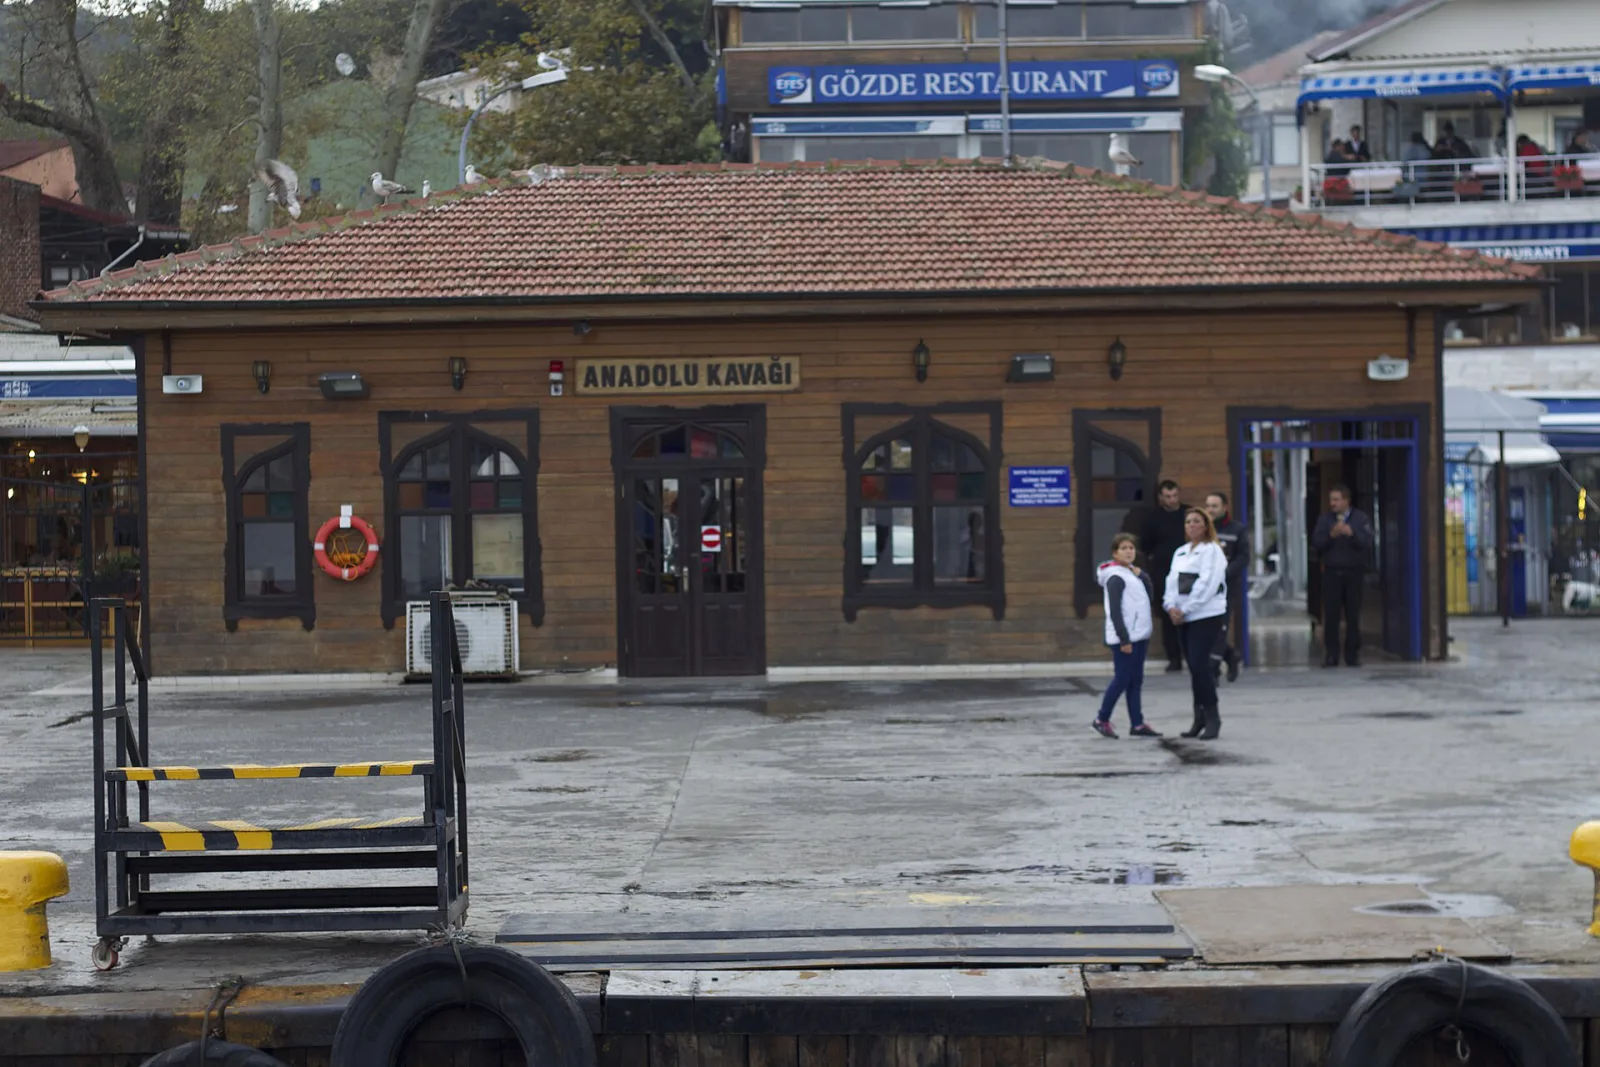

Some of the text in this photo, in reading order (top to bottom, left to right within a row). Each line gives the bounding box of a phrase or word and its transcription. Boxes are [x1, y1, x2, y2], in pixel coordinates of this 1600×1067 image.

[776, 79, 805, 90] EFES
[819, 69, 1109, 97] GÖZDE RESTAURANT
[584, 355, 792, 388] ANADOLU KAVAĞI
